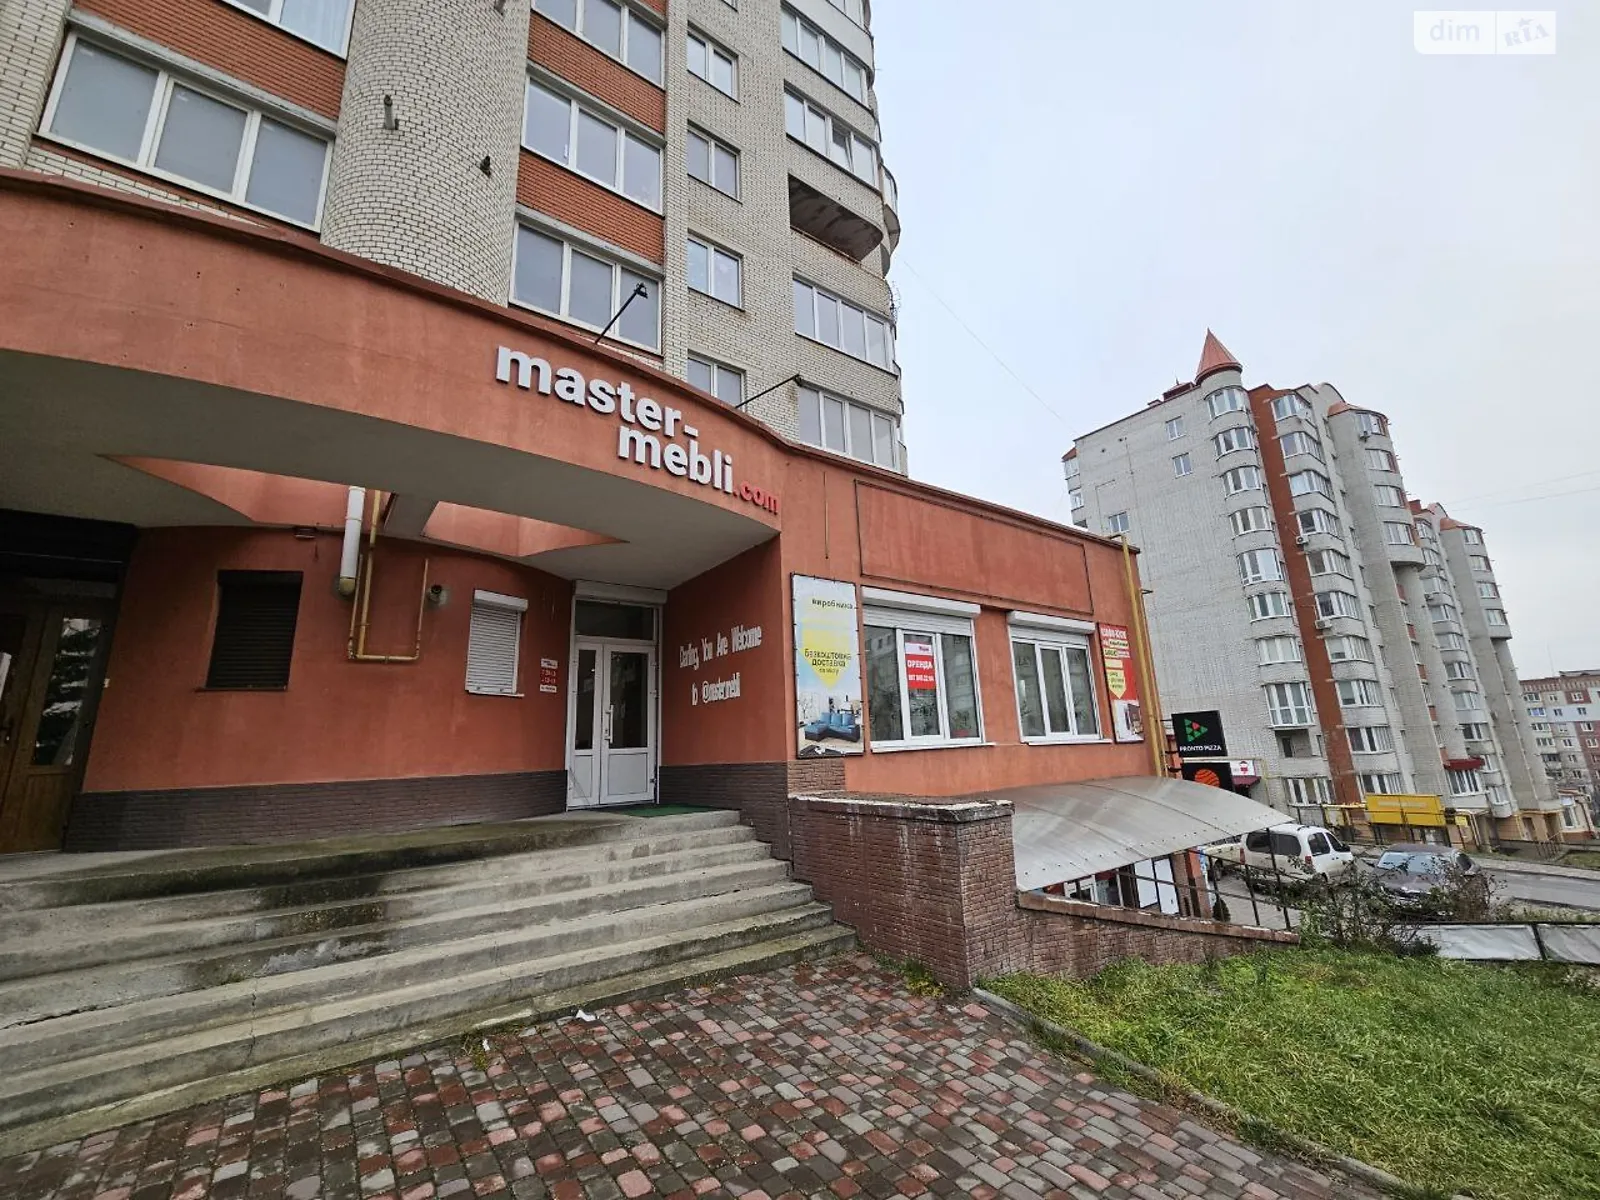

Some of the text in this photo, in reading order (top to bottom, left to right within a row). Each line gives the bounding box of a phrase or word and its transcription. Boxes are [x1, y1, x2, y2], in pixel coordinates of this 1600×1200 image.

[496, 345, 698, 437] master-
[811, 597, 853, 610] виробника
[701, 637, 713, 662] You
[716, 631, 729, 657] Are
[730, 624, 762, 653] Welcome
[907, 659, 933, 670] ОРЕНДА
[1179, 744, 1204, 752] PRONTO
